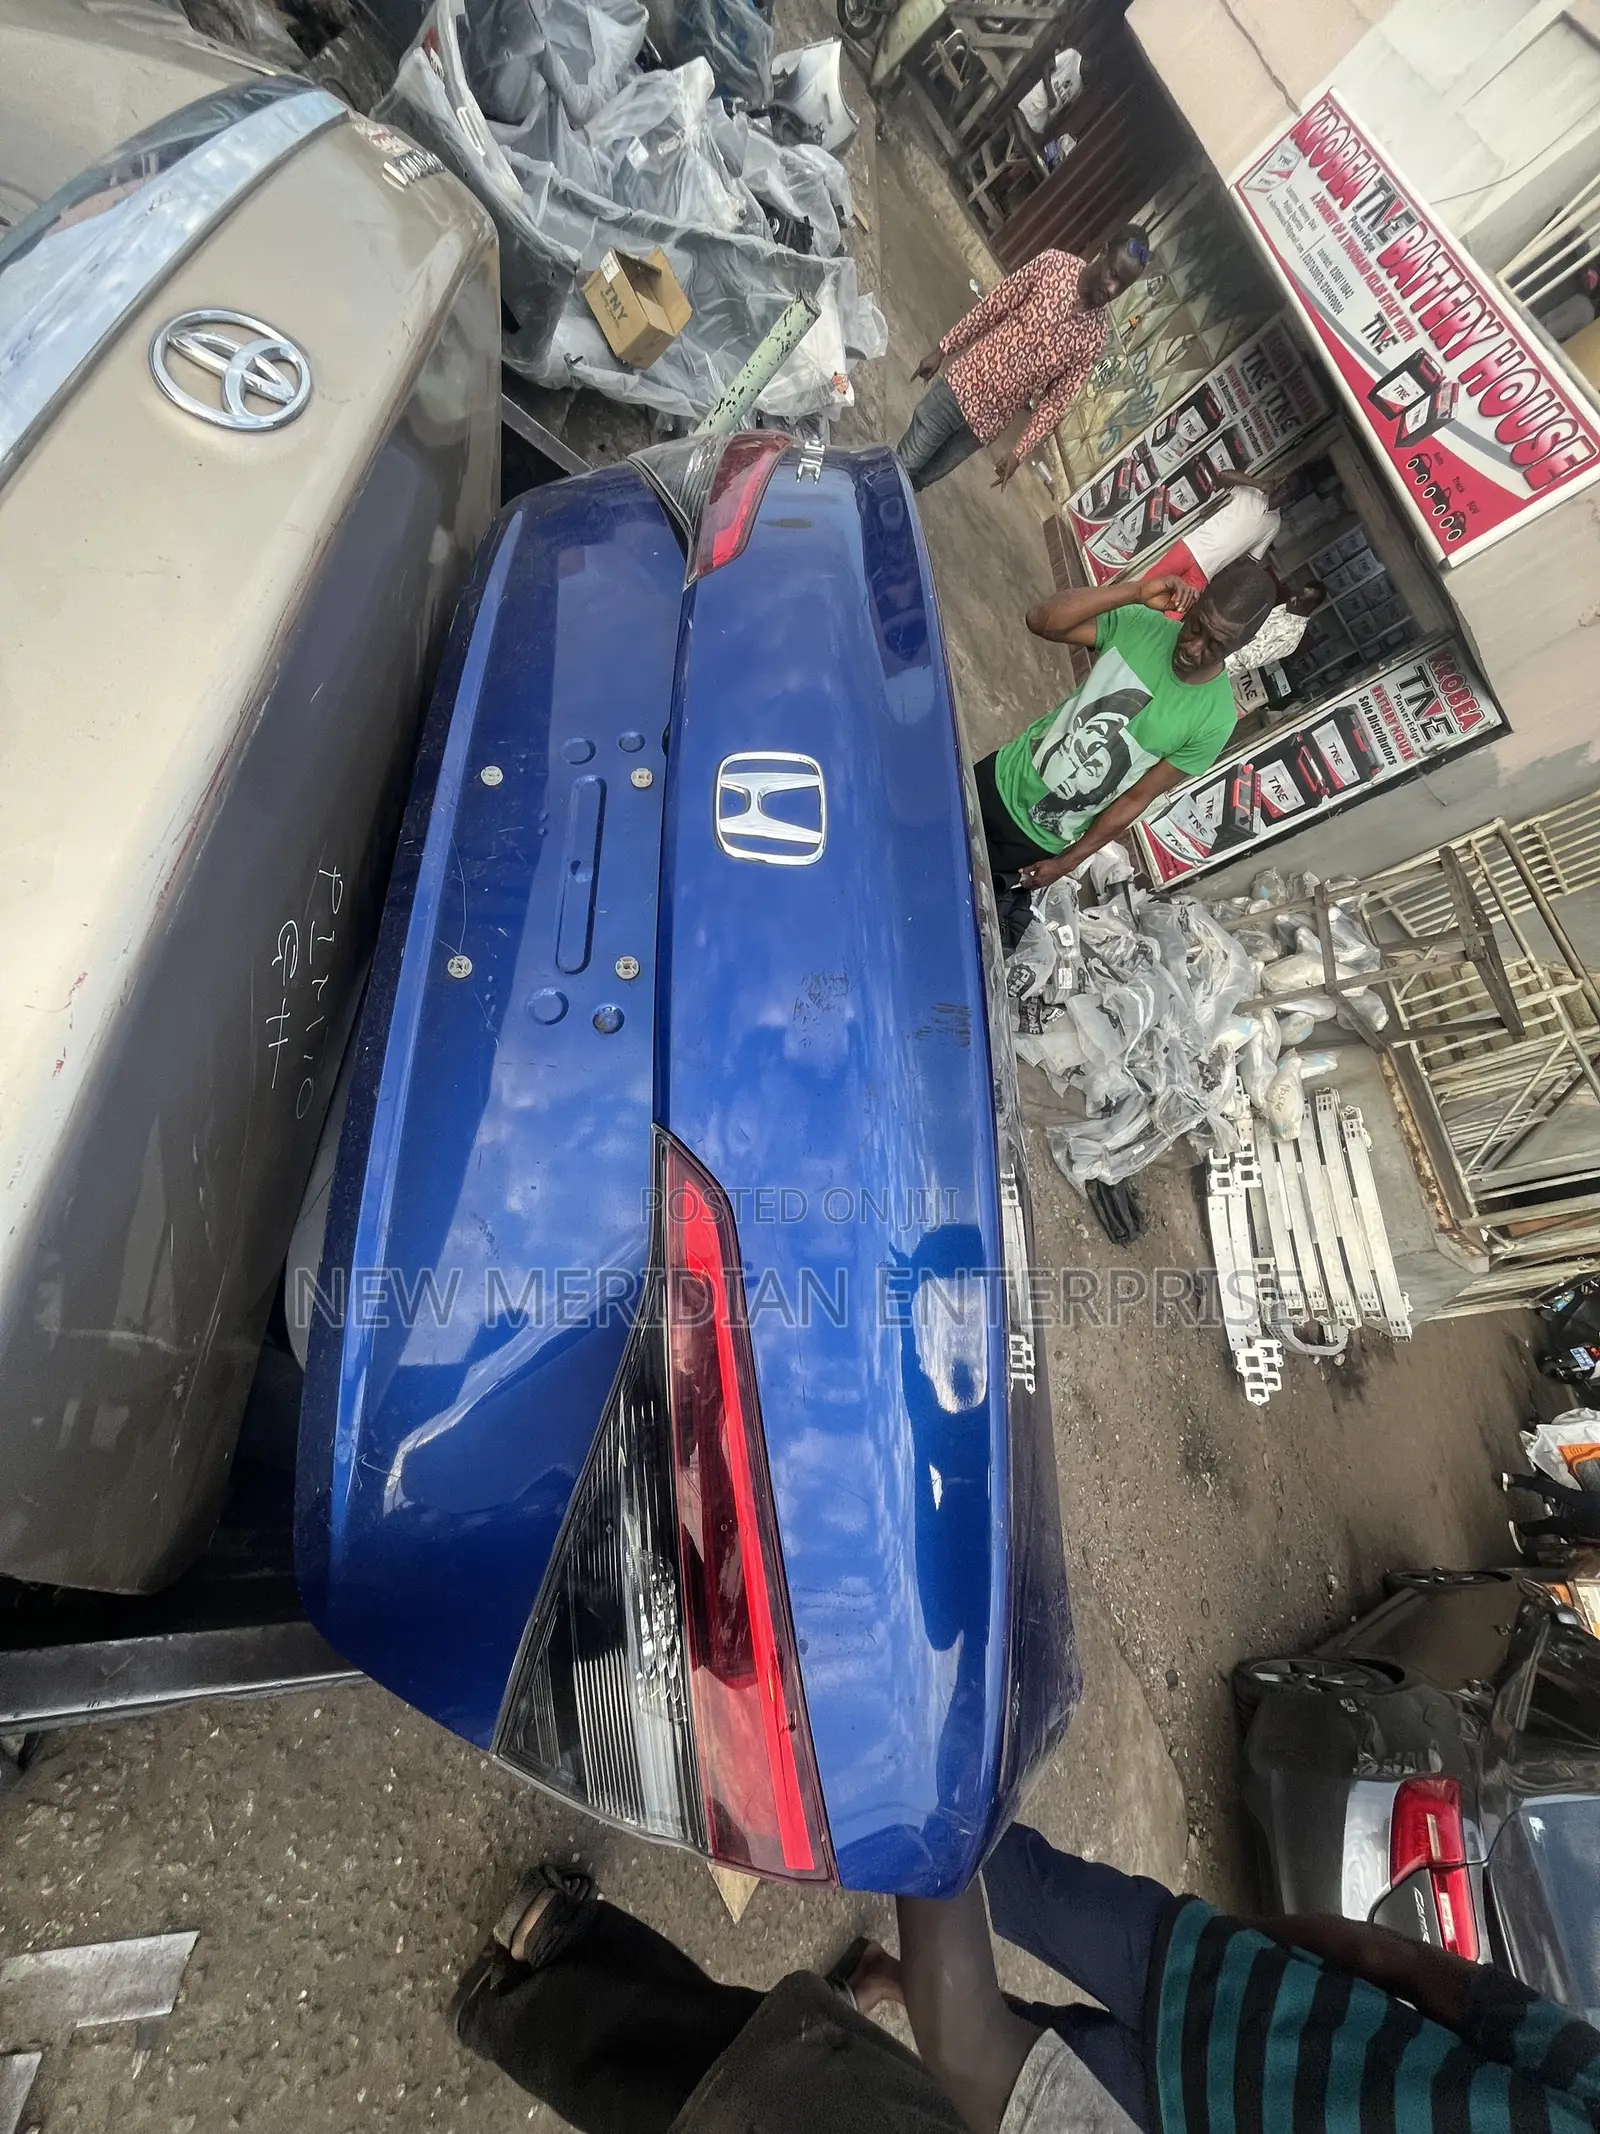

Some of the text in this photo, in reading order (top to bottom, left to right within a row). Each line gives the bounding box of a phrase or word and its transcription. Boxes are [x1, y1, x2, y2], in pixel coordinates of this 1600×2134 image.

[1346, 215, 1378, 253] PowerEdge
[605, 283, 628, 320] TNY
[1288, 98, 1597, 491] KROBEA TNE BATTERY HOUSE
[1361, 312, 1400, 355] TNE
[1378, 291, 1404, 320] START
[1393, 315, 1418, 342] WITH
[1183, 419, 1198, 436] TNE
[1217, 454, 1228, 470] TNE
[1174, 488, 1188, 505] TNE
[1240, 671, 1258, 701] TNE
[1396, 663, 1457, 742] TNE
[1426, 651, 1485, 733] KROBEA
[1359, 695, 1397, 765] Sole Distributors
[1370, 683, 1417, 762] BATTERY HOUSE
[1393, 694, 1420, 743] PowerEdge
[1328, 742, 1344, 766] TNE
[1268, 776, 1289, 802] TNE
[1187, 810, 1208, 836] TNE
[1206, 796, 1214, 820] TNE
[1166, 831, 1190, 854] TNE
